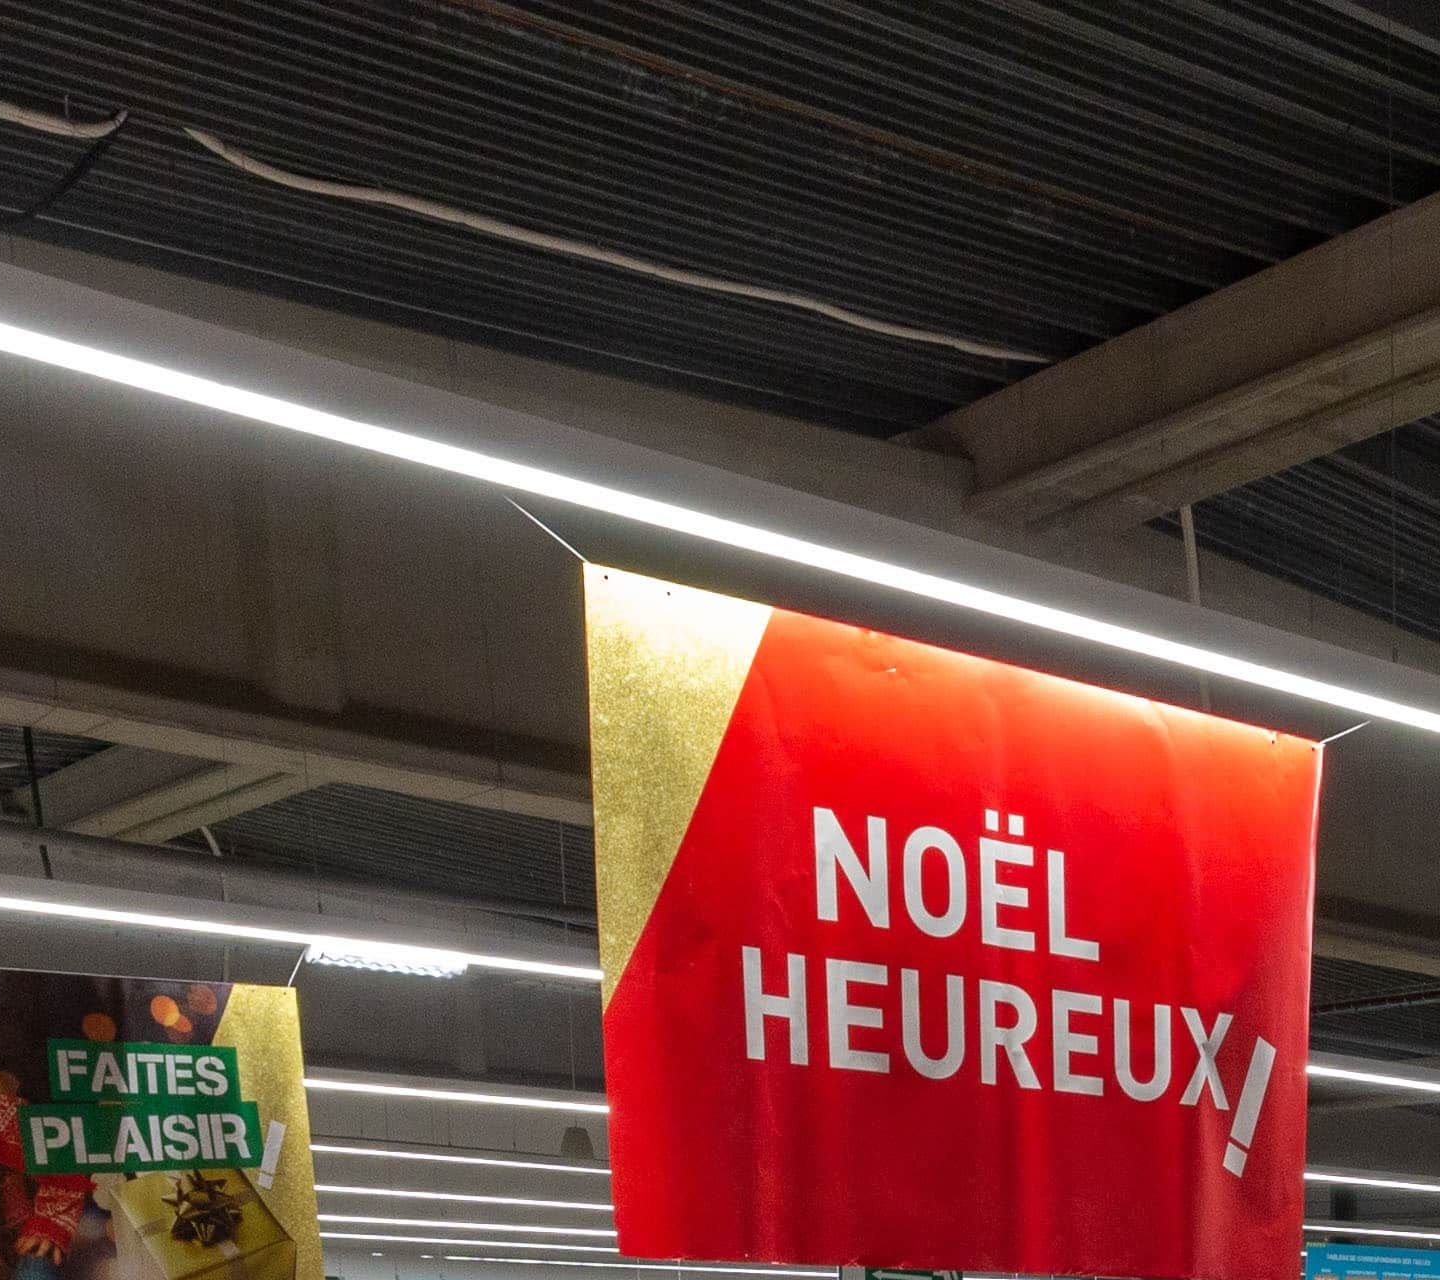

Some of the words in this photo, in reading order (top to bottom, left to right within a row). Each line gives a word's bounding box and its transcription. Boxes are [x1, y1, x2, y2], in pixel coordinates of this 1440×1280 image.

[812, 806, 1101, 963] NOËL
[57, 1049, 230, 1098] FAITES
[29, 1112, 253, 1167] PLAISIR
